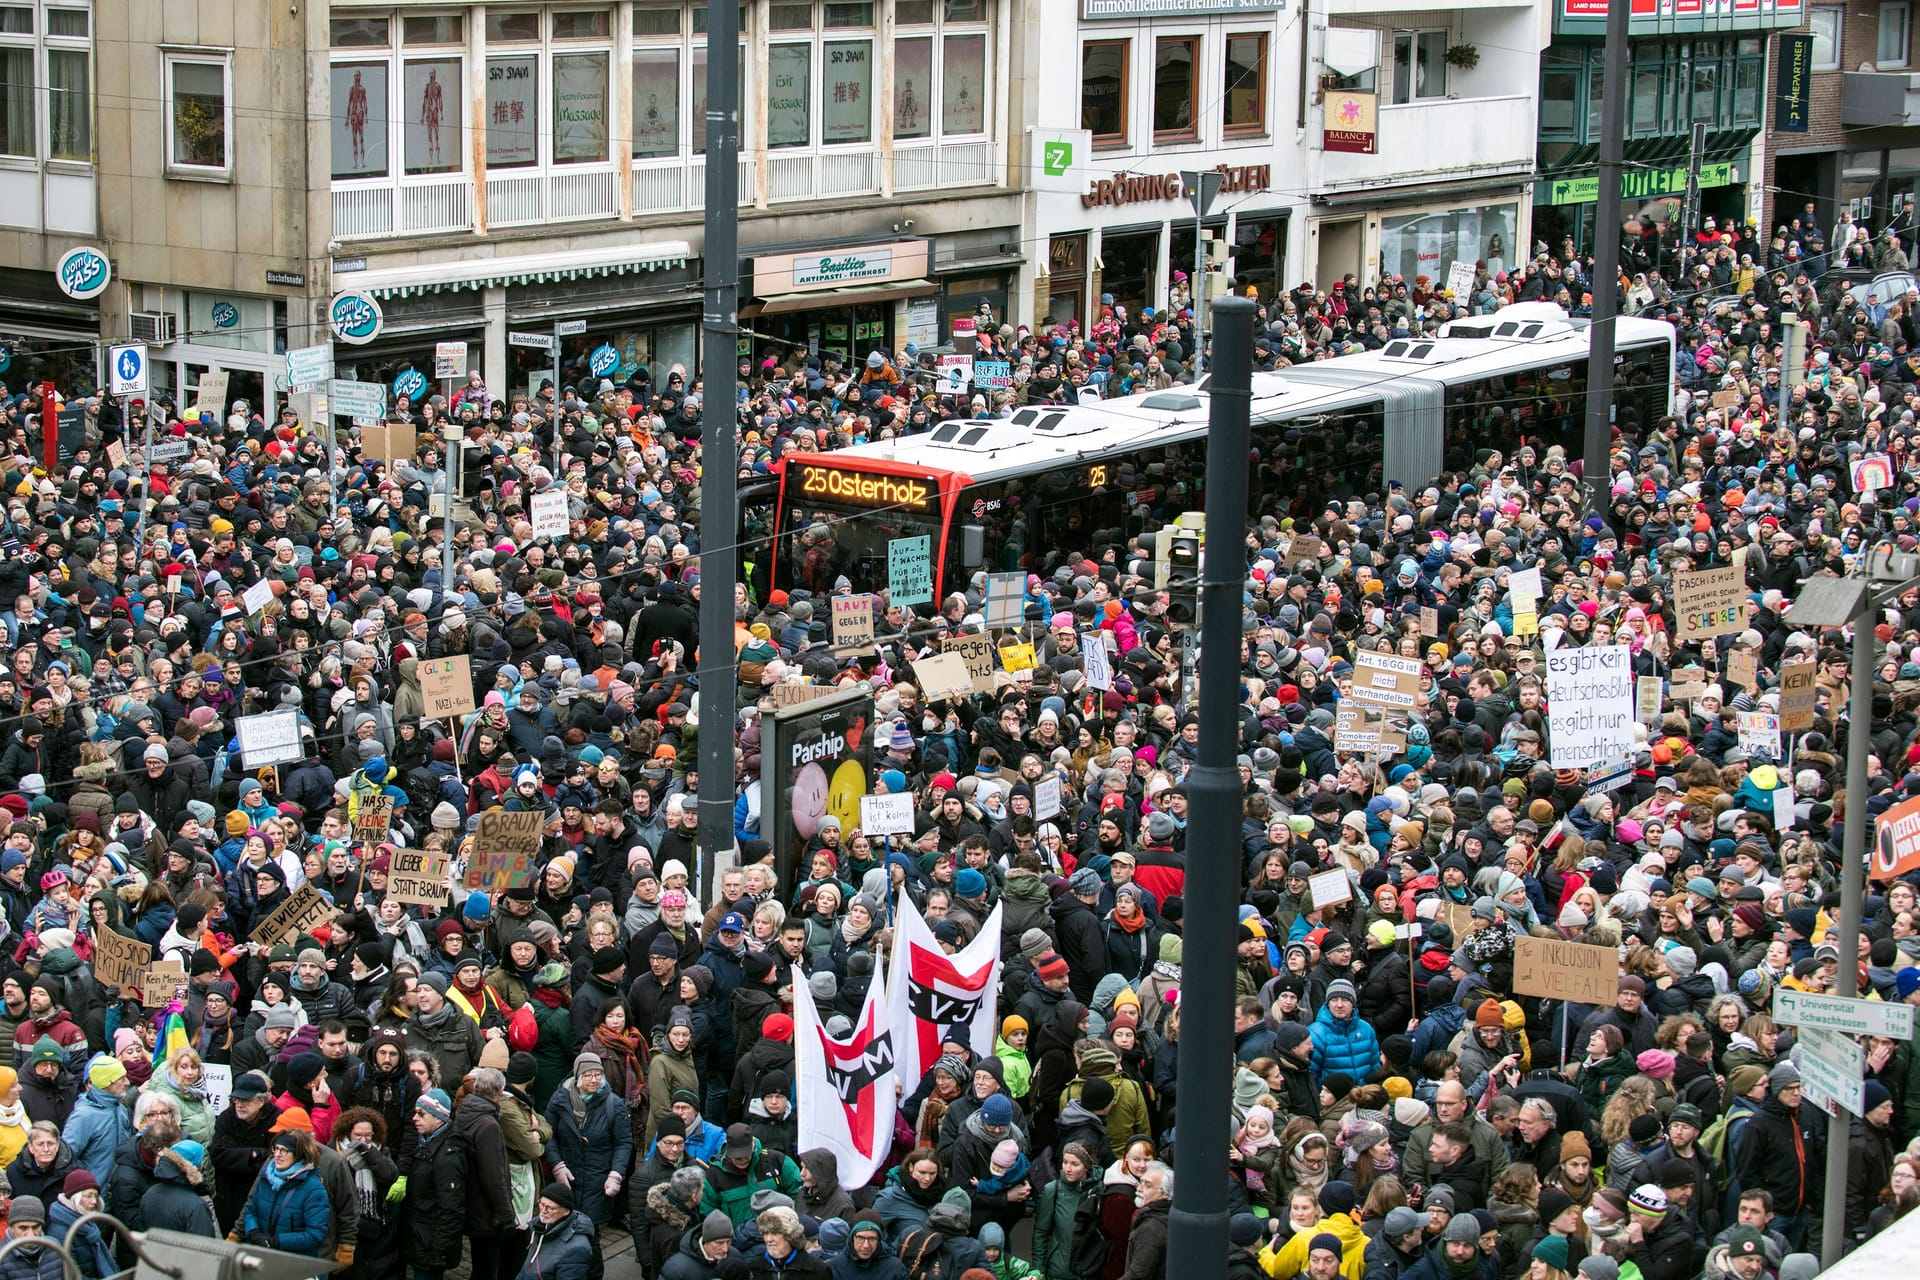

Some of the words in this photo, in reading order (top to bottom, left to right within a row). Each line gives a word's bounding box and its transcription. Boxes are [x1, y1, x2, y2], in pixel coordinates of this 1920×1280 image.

[1792, 41, 1803, 109] TIMEPARTNER
[1330, 131, 1366, 140] BALANCE
[1047, 151, 1056, 160] Dr.
[1052, 150, 1065, 169] Z
[1083, 172, 1179, 208] GRÖNING
[1206, 164, 1271, 193] ÄTJEN
[66, 257, 84, 276] vom
[820, 257, 867, 273] Basilico
[850, 268, 886, 278] FEINKOST
[66, 257, 101, 294] FASS
[267, 272, 304, 286] Bischofsnadel
[214, 306, 234, 328] FASS
[336, 303, 354, 317] vom
[336, 305, 371, 336] FASS
[512, 334, 549, 347] Bischofsnadel
[591, 351, 606, 366] vom
[592, 350, 617, 378] FASS
[120, 380, 140, 391] ZONE
[395, 375, 411, 391] vom
[154, 445, 185, 458] Bischofsnadel
[1090, 464, 1106, 488] 25
[803, 467, 827, 493] 25
[828, 470, 928, 507] Osterholz
[986, 500, 1001, 511] BSAG
[900, 554, 930, 565] WACHEN
[894, 569, 908, 577] FÜR
[1679, 572, 1735, 592] FASCHISMUS
[836, 600, 869, 612] LAUT
[839, 616, 867, 627] GEGEN
[1185, 636, 1191, 648] 3
[1359, 655, 1374, 665] Art.
[1378, 658, 1388, 668] 16
[1390, 661, 1404, 670] GG
[1406, 662, 1417, 672] ist
[1549, 657, 1567, 672] es
[1570, 648, 1597, 675] gibt
[1600, 649, 1627, 668] kein
[1373, 676, 1395, 689] nicht
[1785, 672, 1812, 690] KEIN
[1354, 687, 1413, 705] verhandelbar
[1338, 713, 1356, 721] geht
[1551, 715, 1565, 731] es
[1566, 707, 1594, 735] gibt
[1599, 713, 1626, 729] nur
[1337, 732, 1380, 741] Demokrati
[792, 731, 844, 767] Parship
[362, 796, 388, 809] HASS
[868, 796, 893, 809] Hass
[372, 807, 382, 815] IST
[870, 811, 880, 822] ist
[886, 810, 909, 820] keine
[358, 814, 388, 828] KEINE
[482, 812, 542, 838] BRAUN
[395, 853, 422, 872] LIEBER
[420, 856, 448, 875] BUNT
[391, 878, 420, 895] STATT
[420, 880, 449, 899] BRAUN
[258, 921, 279, 944] NIE
[274, 887, 315, 926] WIEDER
[99, 928, 124, 958] NAZIS
[125, 943, 151, 966] SIND
[1542, 943, 1601, 970] INKLUSION
[146, 975, 161, 985] Kein
[163, 974, 188, 984] Mensch
[1541, 970, 1615, 1001] VIELFALT
[1800, 999, 1855, 1014] Universität
[1800, 1012, 1867, 1028] Schwachhausen
